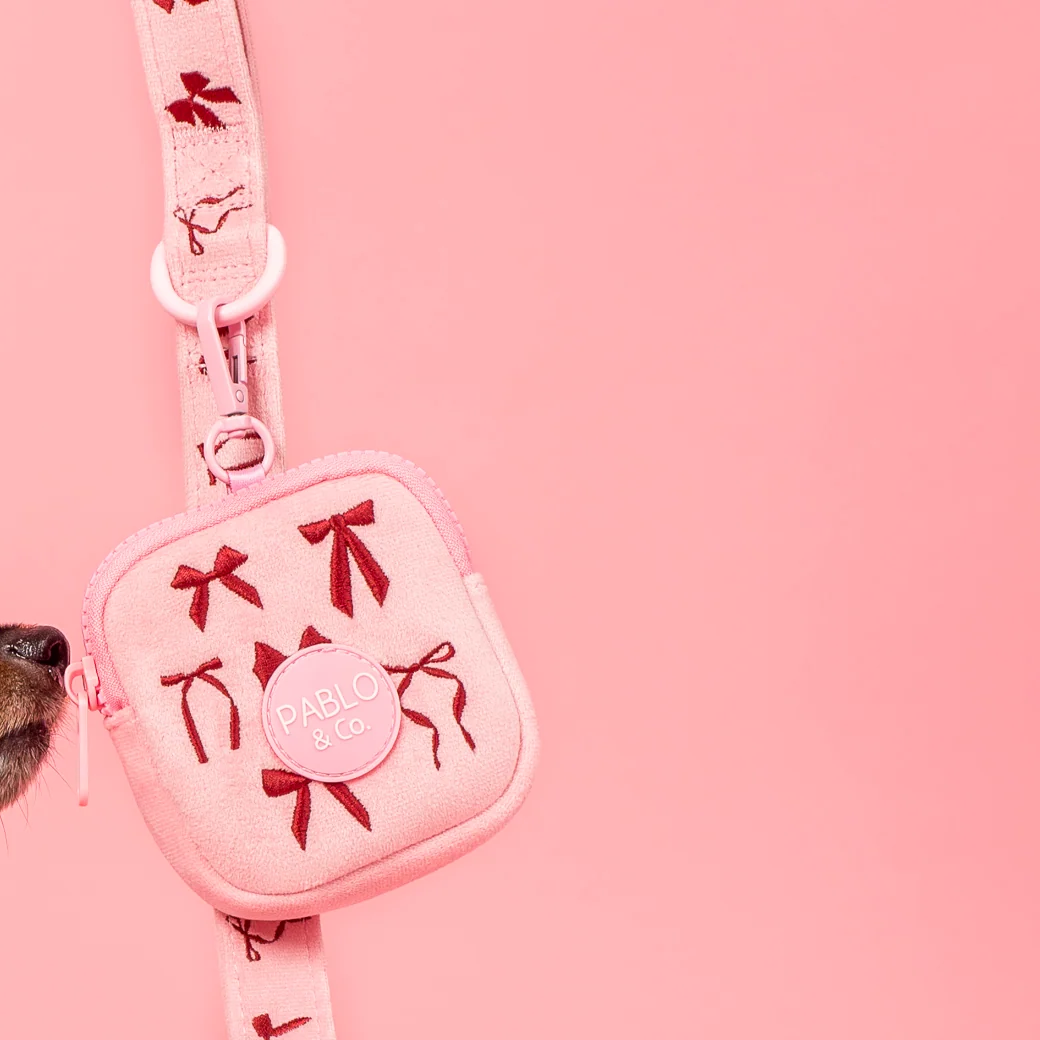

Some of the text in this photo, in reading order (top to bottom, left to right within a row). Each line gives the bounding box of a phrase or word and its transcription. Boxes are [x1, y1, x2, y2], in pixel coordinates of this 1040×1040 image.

[276, 672, 379, 735] PABLO
[312, 718, 372, 751] & Co.
